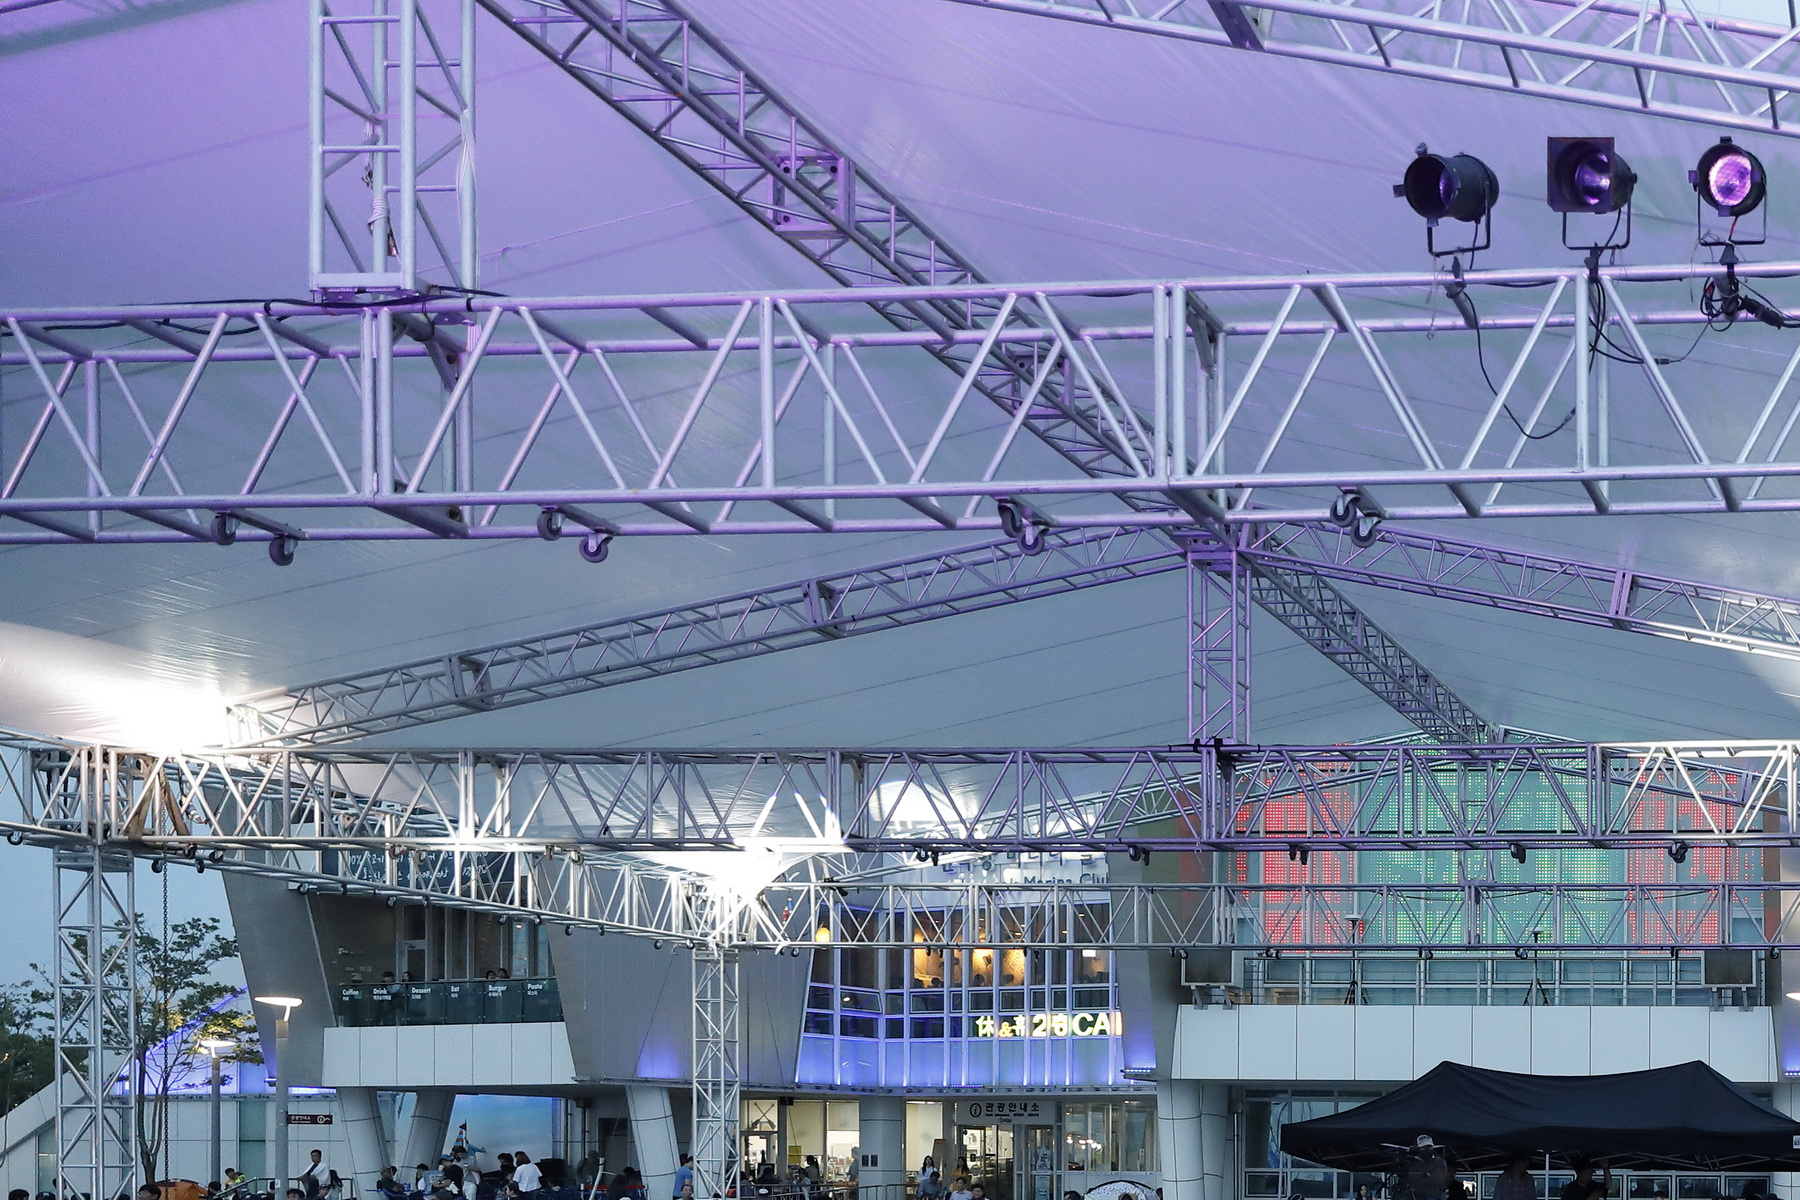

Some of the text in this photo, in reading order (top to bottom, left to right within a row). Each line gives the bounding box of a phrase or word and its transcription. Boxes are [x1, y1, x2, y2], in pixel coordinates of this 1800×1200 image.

[342, 988, 359, 996] Coffee
[488, 985, 508, 993] Burger
[985, 1102, 1039, 1112] 관광안내소
